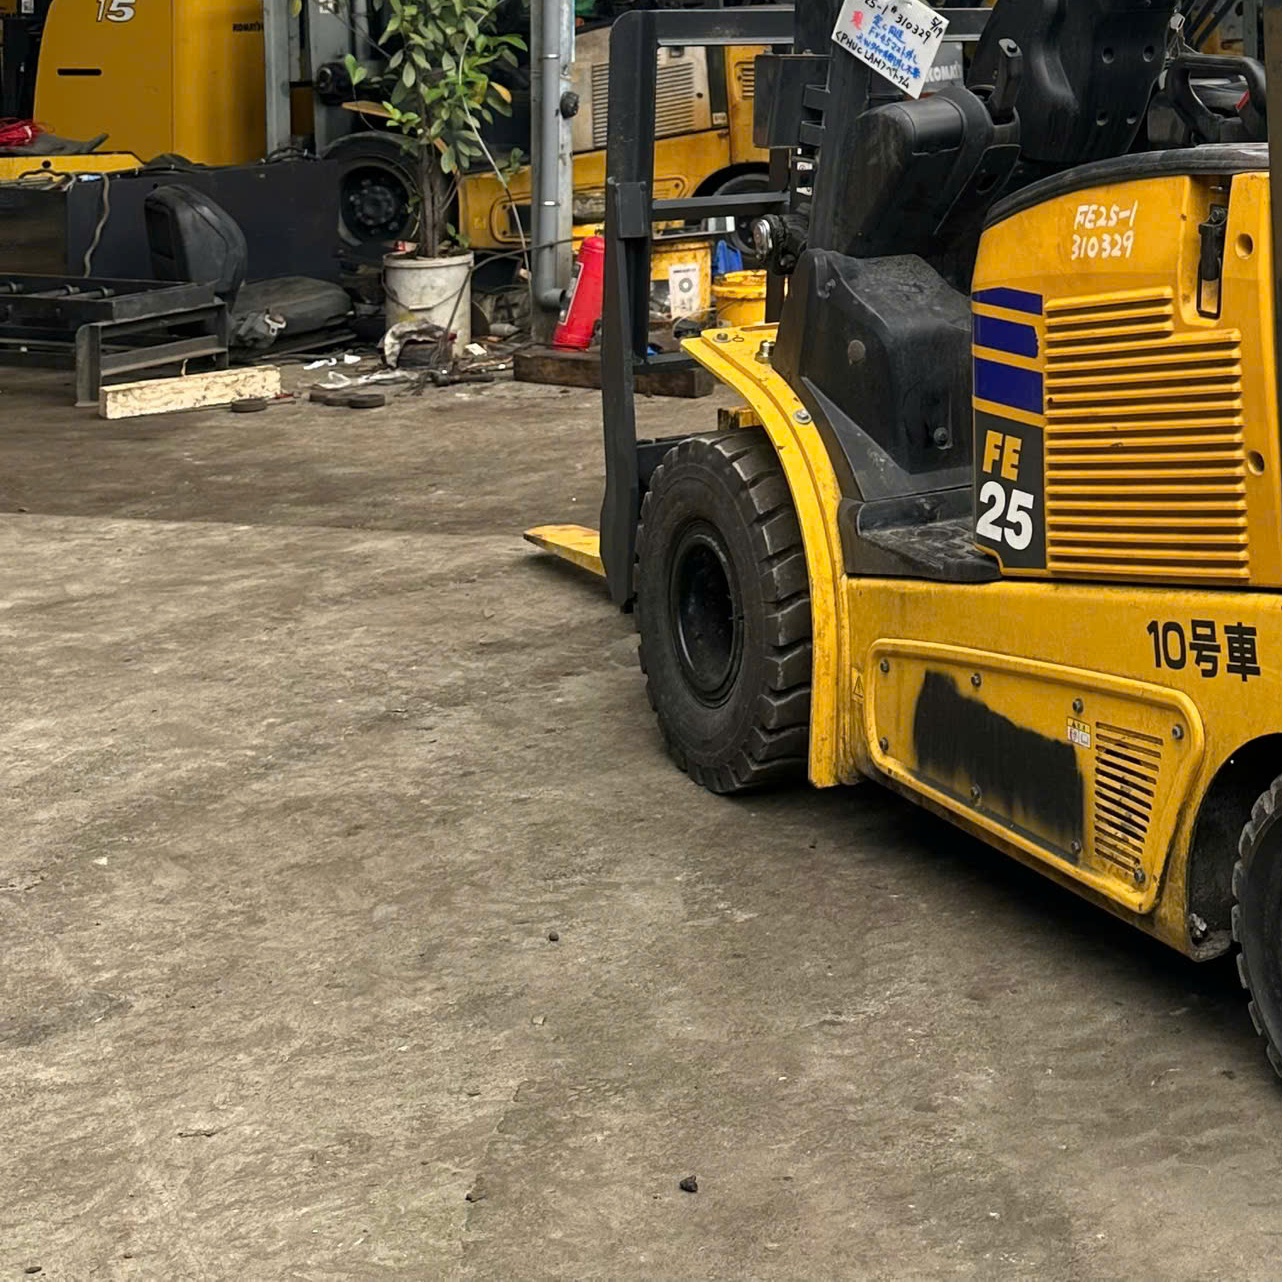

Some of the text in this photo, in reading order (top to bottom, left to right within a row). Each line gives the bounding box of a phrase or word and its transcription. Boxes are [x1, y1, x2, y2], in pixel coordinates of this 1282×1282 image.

[1073, 199, 1138, 231] FE25-1
[1071, 229, 1135, 261] 310329
[982, 429, 1023, 482] FE
[976, 480, 1035, 551] 25
[1146, 618, 1262, 683] 10号車
